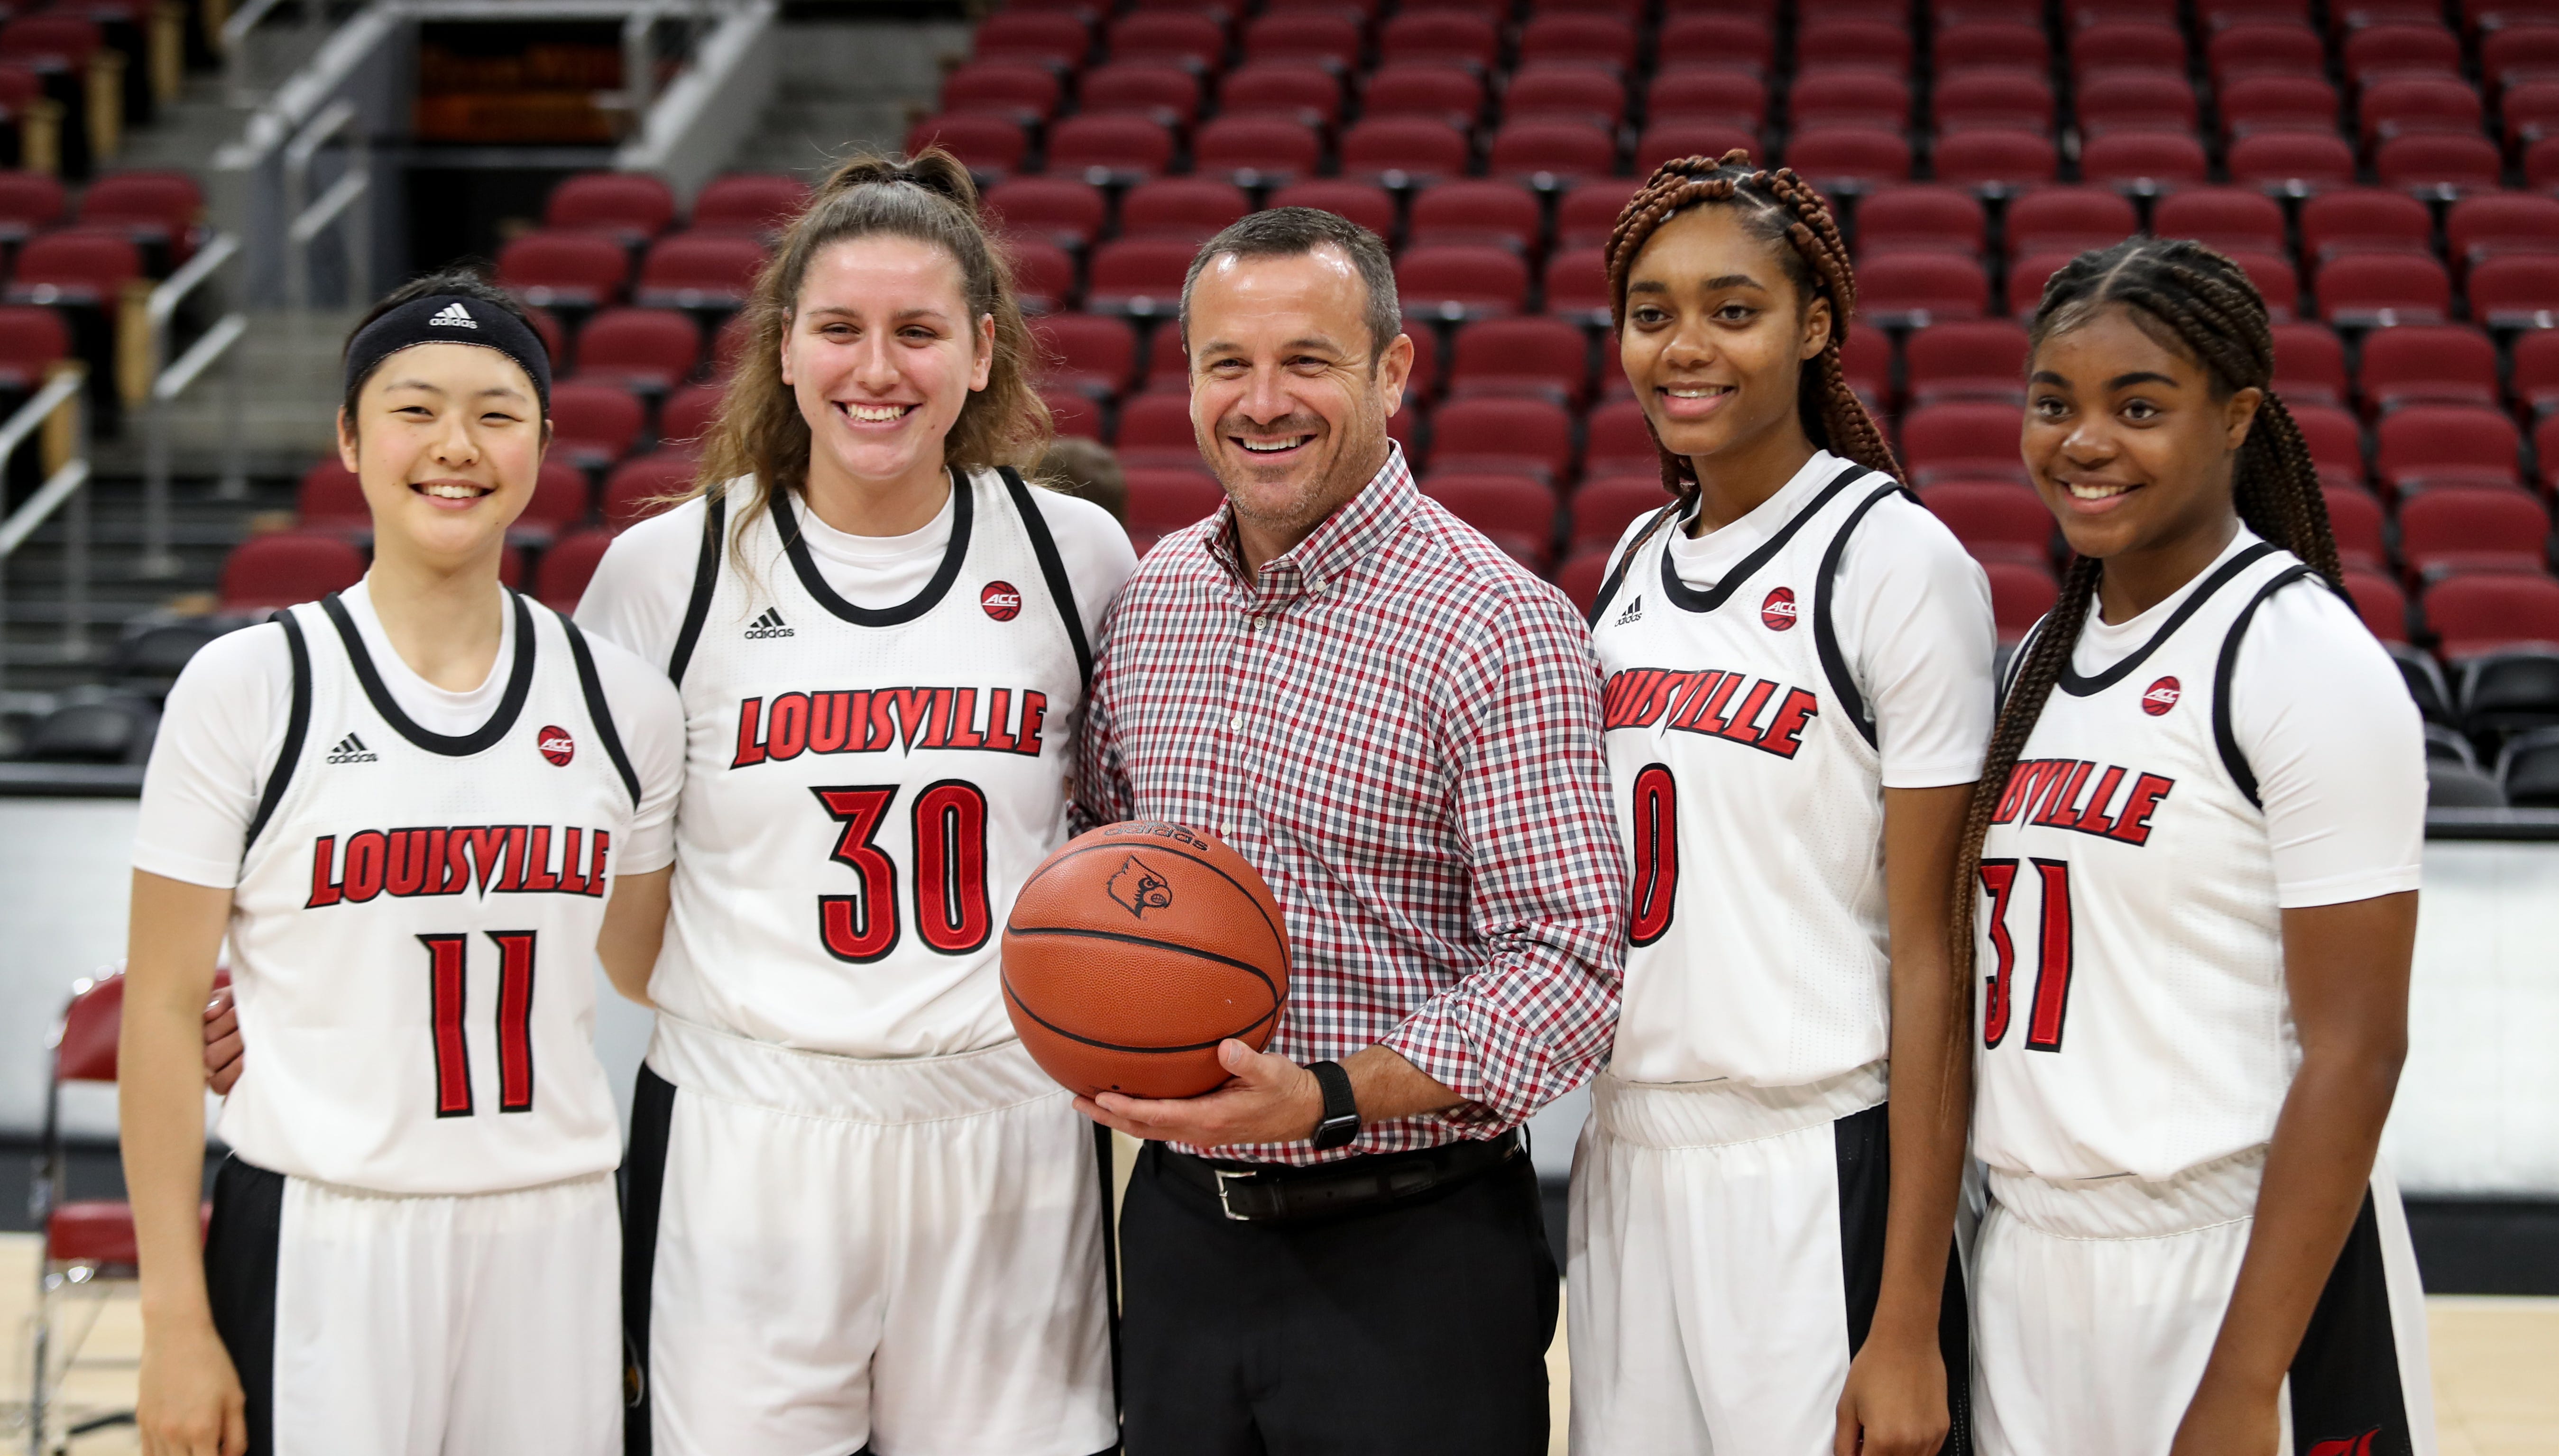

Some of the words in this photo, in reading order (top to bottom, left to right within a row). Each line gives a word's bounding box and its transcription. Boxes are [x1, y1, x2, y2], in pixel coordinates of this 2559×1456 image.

[429, 317, 478, 329] adidas
[985, 594, 1020, 604] ACC
[1765, 601, 1796, 614] ACC
[1614, 613, 1642, 627] adidas
[744, 626, 795, 639] adidas
[2145, 688, 2182, 701] ACC
[1602, 667, 1818, 760] OUISVILLE
[729, 687, 1047, 770] LOUISVILLE
[540, 738, 573, 750] ACC
[327, 752, 378, 764] adidas
[1104, 824, 1209, 851] adidas
[1629, 762, 1679, 948] 0
[303, 825, 609, 909] LOUISVILLE
[808, 778, 994, 965] 30
[1980, 857, 2073, 1053] 31
[414, 929, 537, 1118] 11
